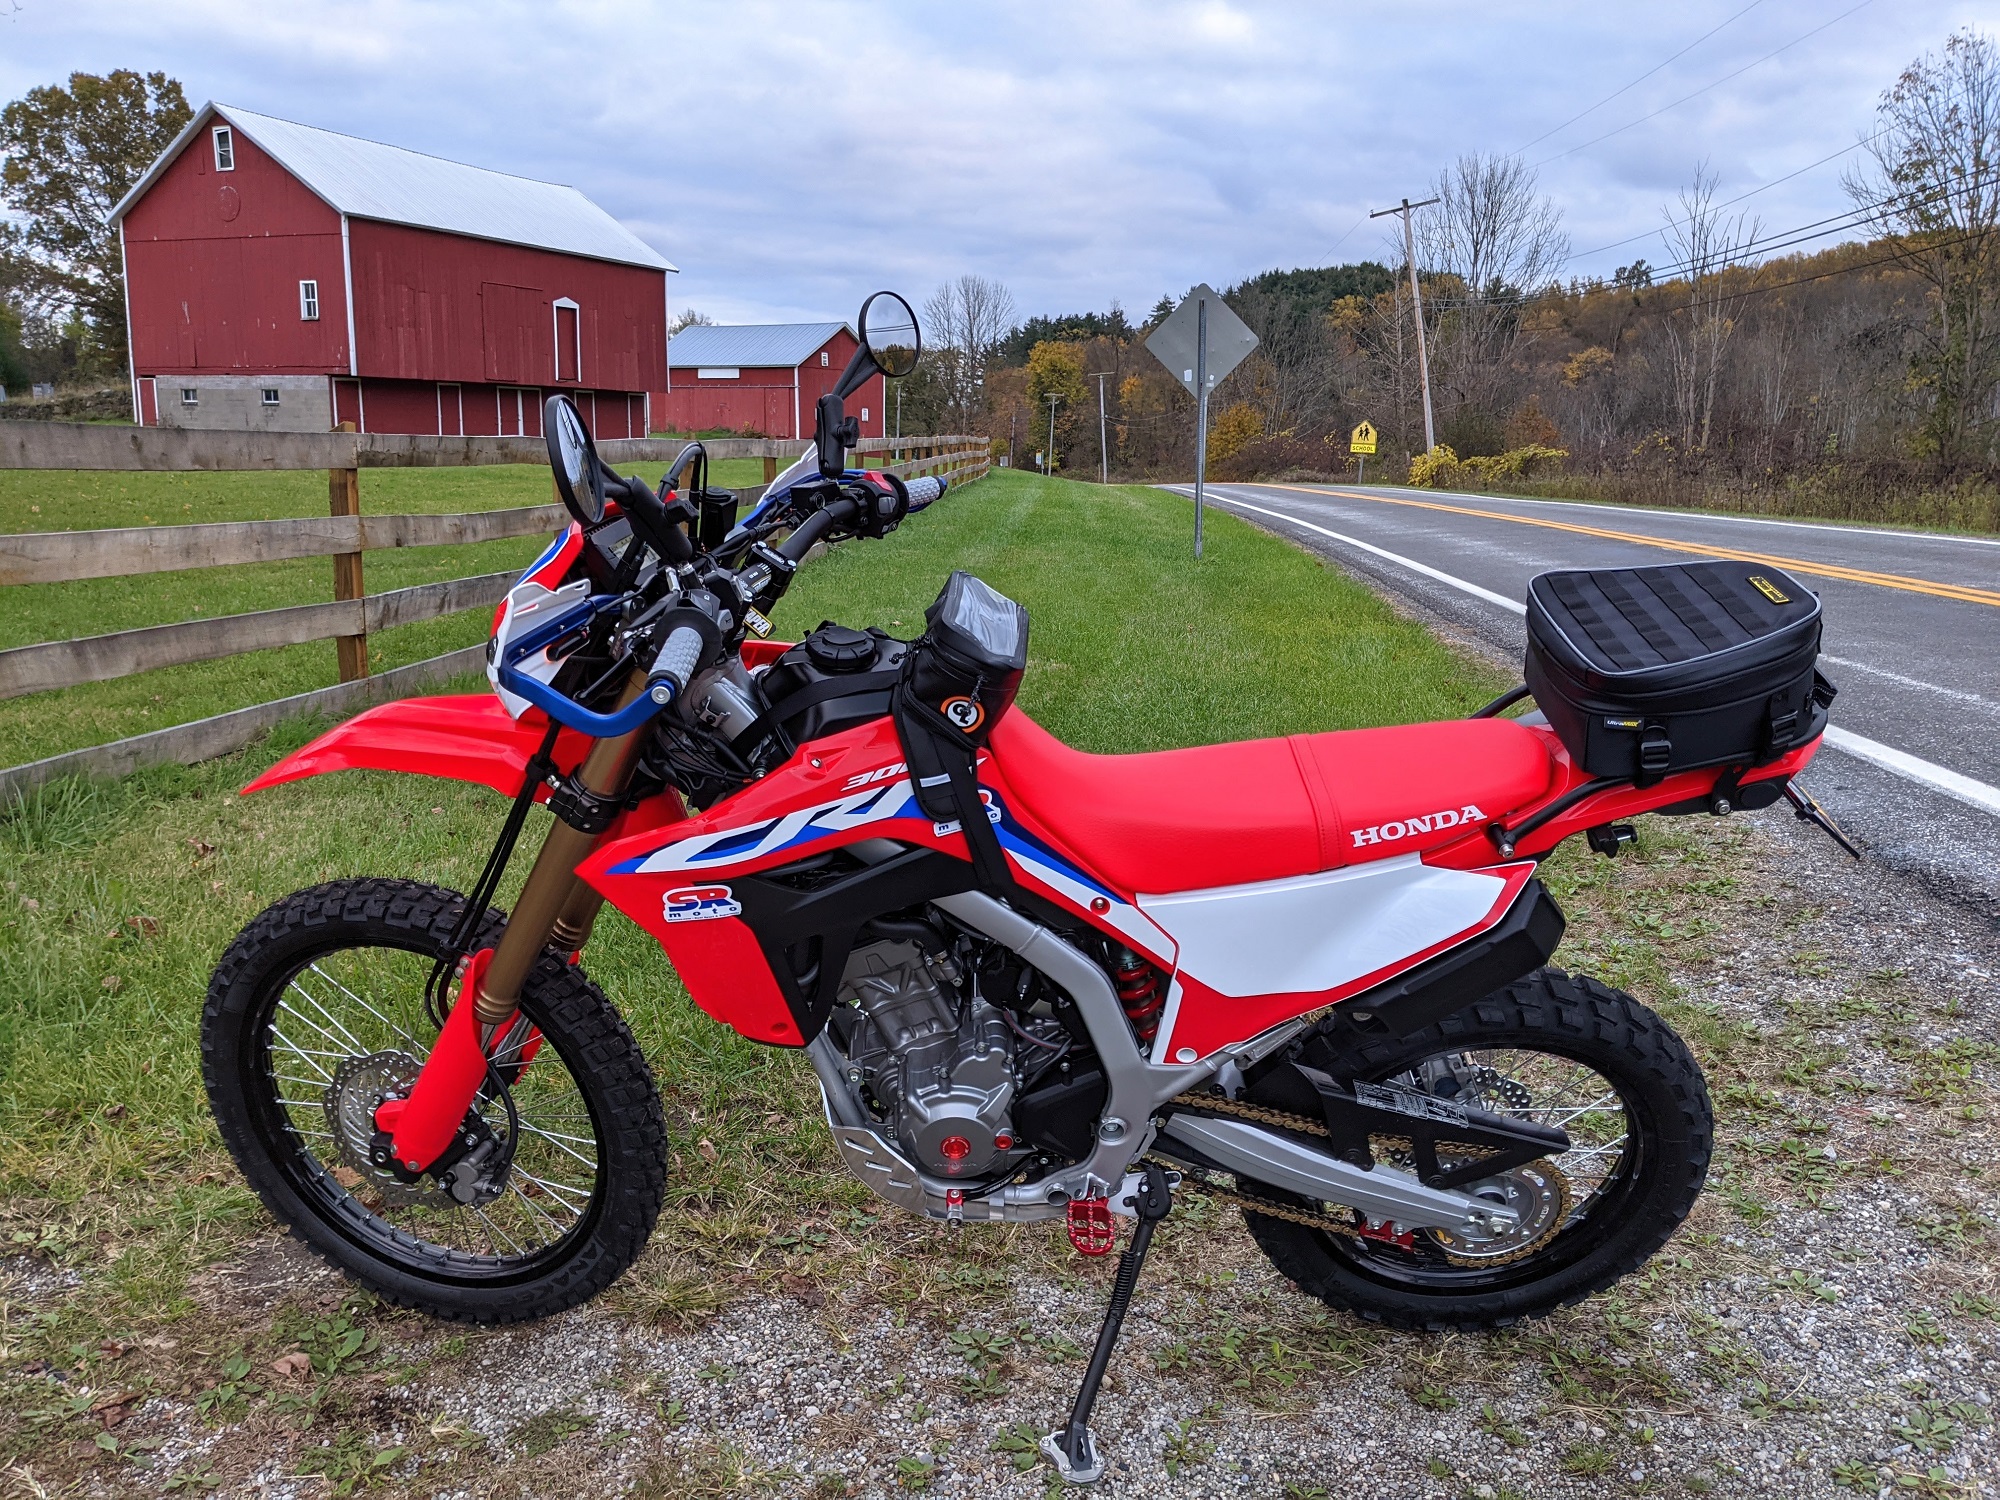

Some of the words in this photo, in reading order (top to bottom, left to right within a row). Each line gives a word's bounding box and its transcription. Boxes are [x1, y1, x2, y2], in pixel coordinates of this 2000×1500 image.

[745, 608, 771, 635] APER
[1350, 804, 1488, 848] HONDA
[666, 887, 735, 913] SR
[668, 907, 738, 918] moto
